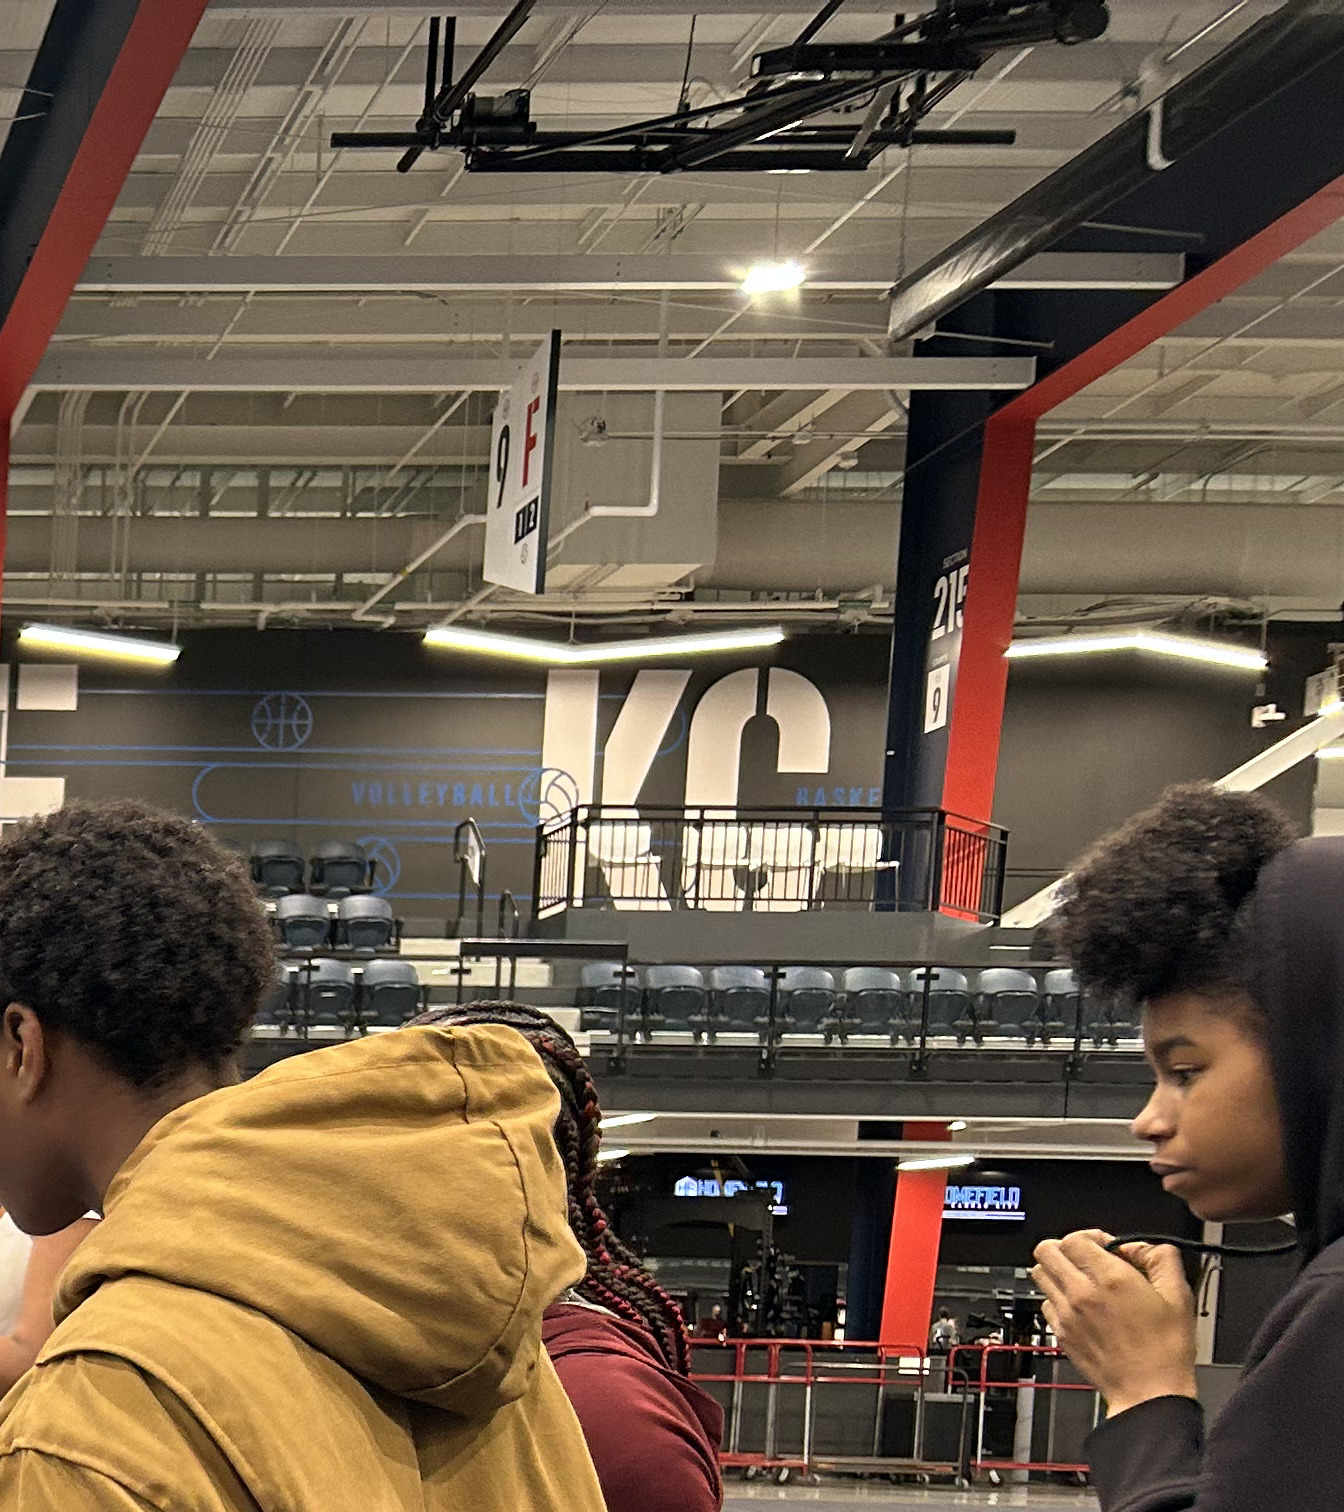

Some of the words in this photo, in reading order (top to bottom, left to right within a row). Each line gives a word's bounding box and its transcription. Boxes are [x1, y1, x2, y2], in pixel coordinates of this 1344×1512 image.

[496, 424, 510, 509] 9
[522, 396, 540, 488] F
[352, 782, 516, 808] VOLLEYBALL
